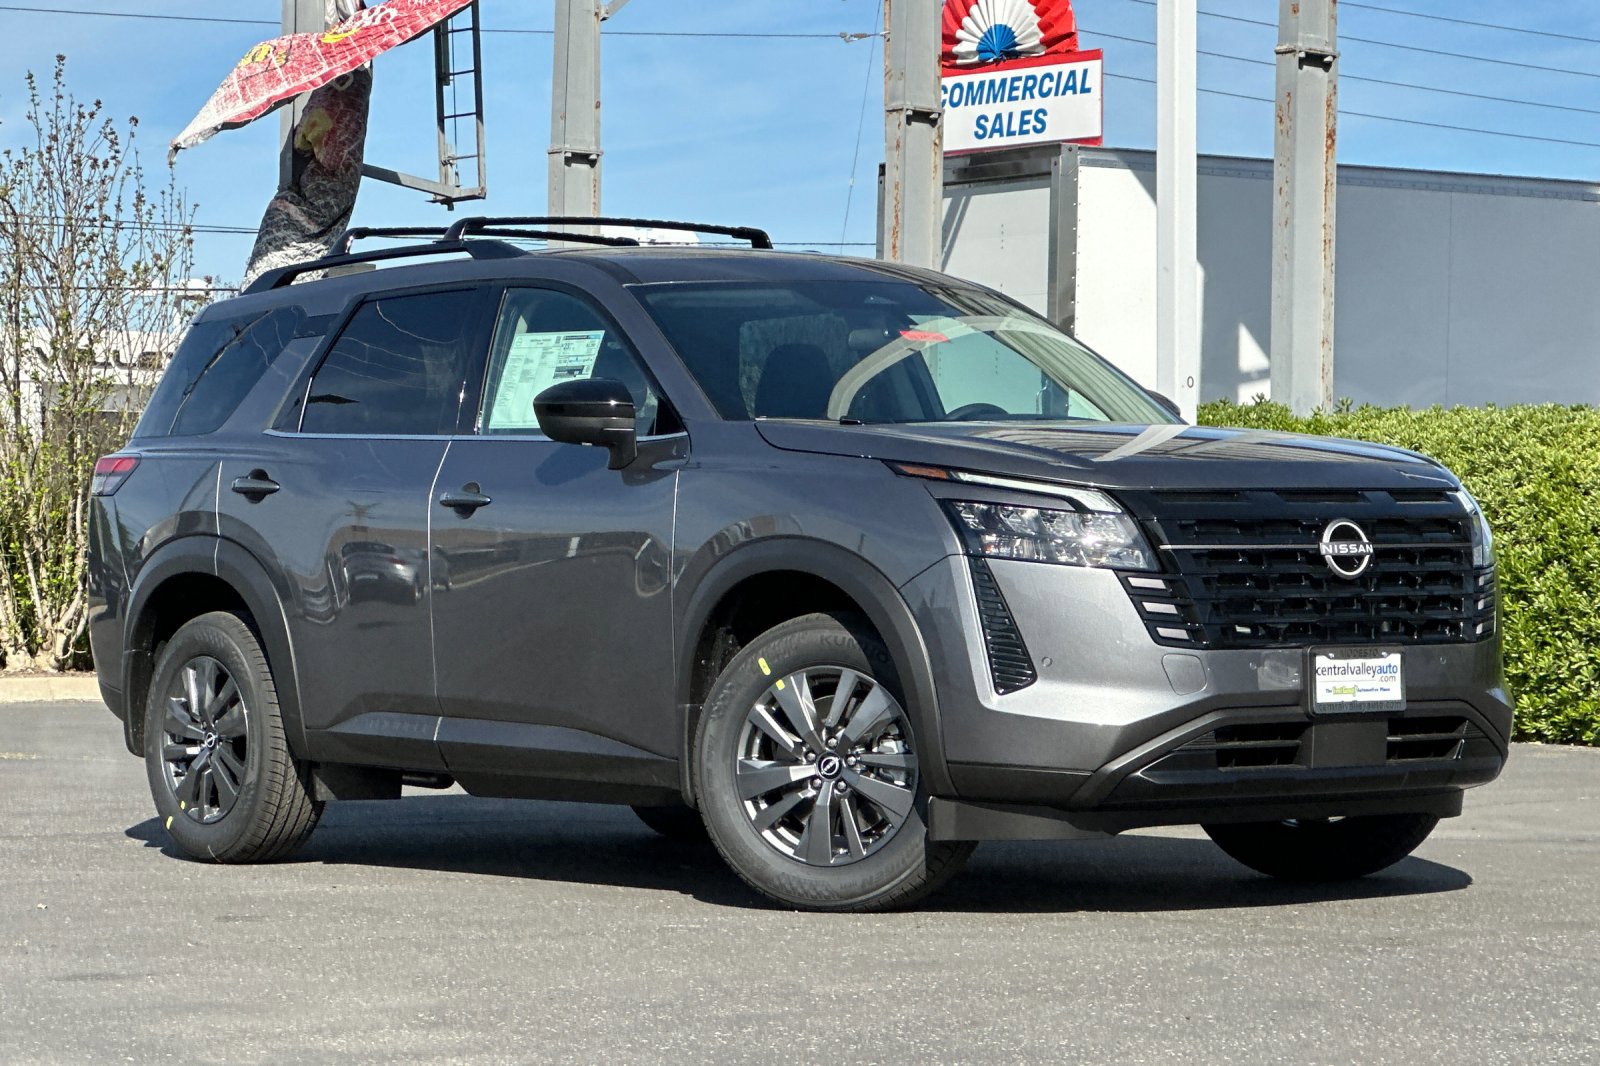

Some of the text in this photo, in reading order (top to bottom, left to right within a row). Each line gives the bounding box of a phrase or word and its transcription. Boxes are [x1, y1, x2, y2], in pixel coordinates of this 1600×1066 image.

[974, 108, 1048, 140] SALES
[1322, 543, 1374, 554] NISSAN
[1316, 662, 1398, 678] centralvalleyauto
